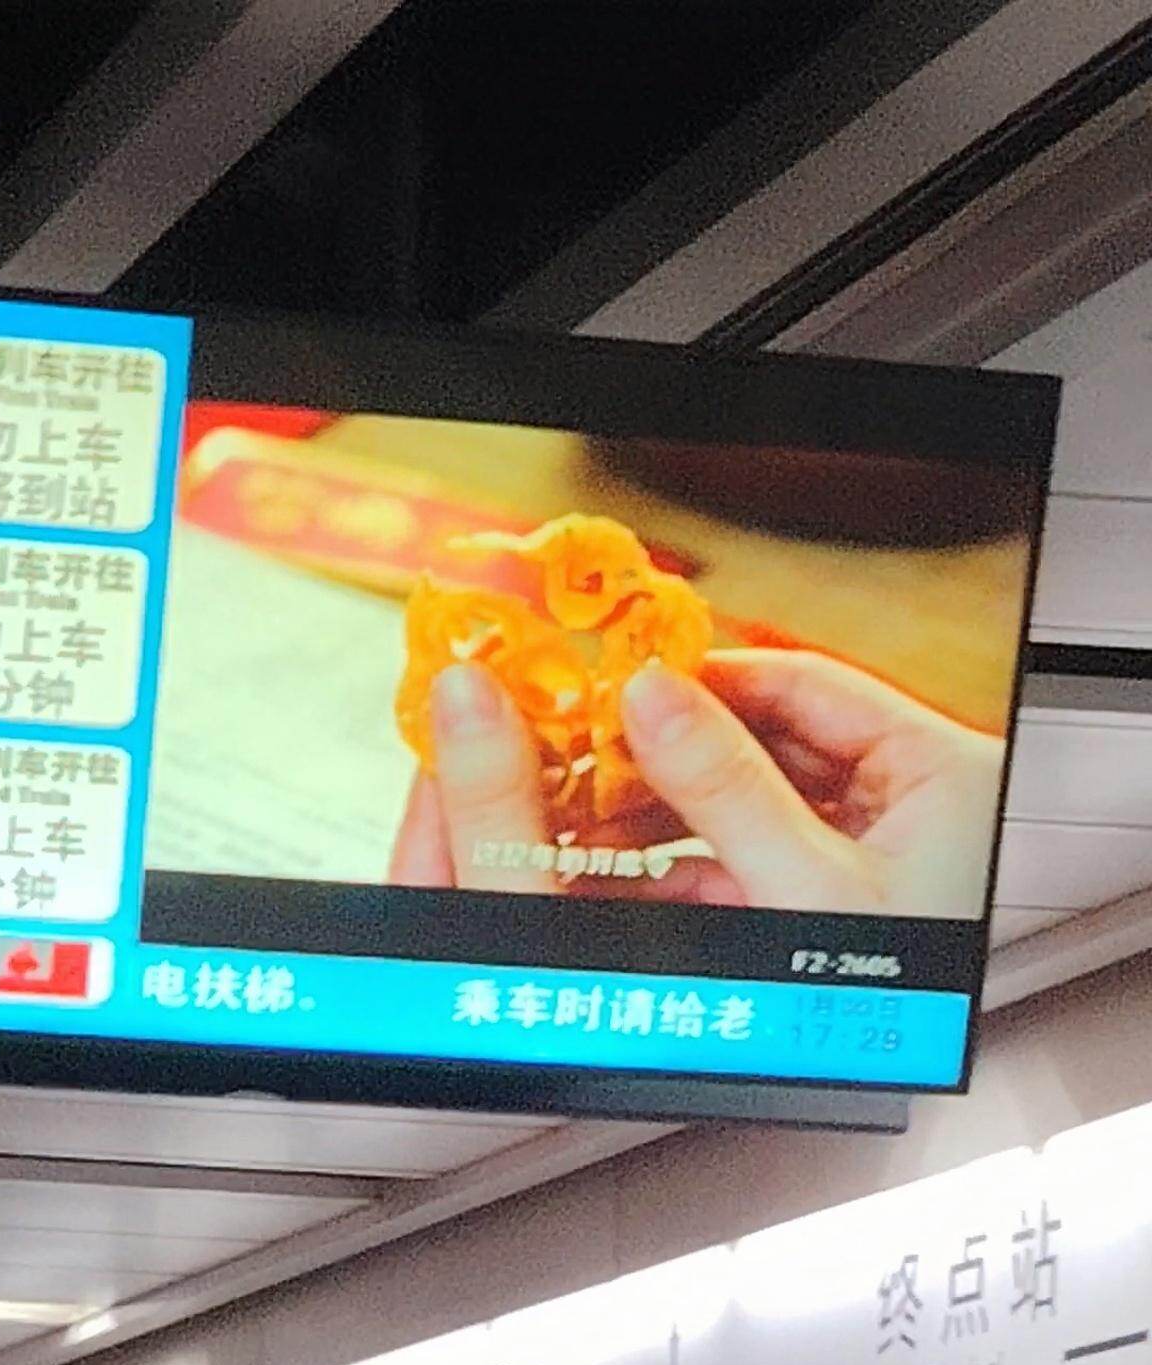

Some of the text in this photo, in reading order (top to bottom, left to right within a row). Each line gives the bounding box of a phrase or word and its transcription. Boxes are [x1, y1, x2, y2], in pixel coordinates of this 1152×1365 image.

[451, 978, 758, 1042] 乘车时请给老
[875, 1198, 1063, 1356] 终点站
